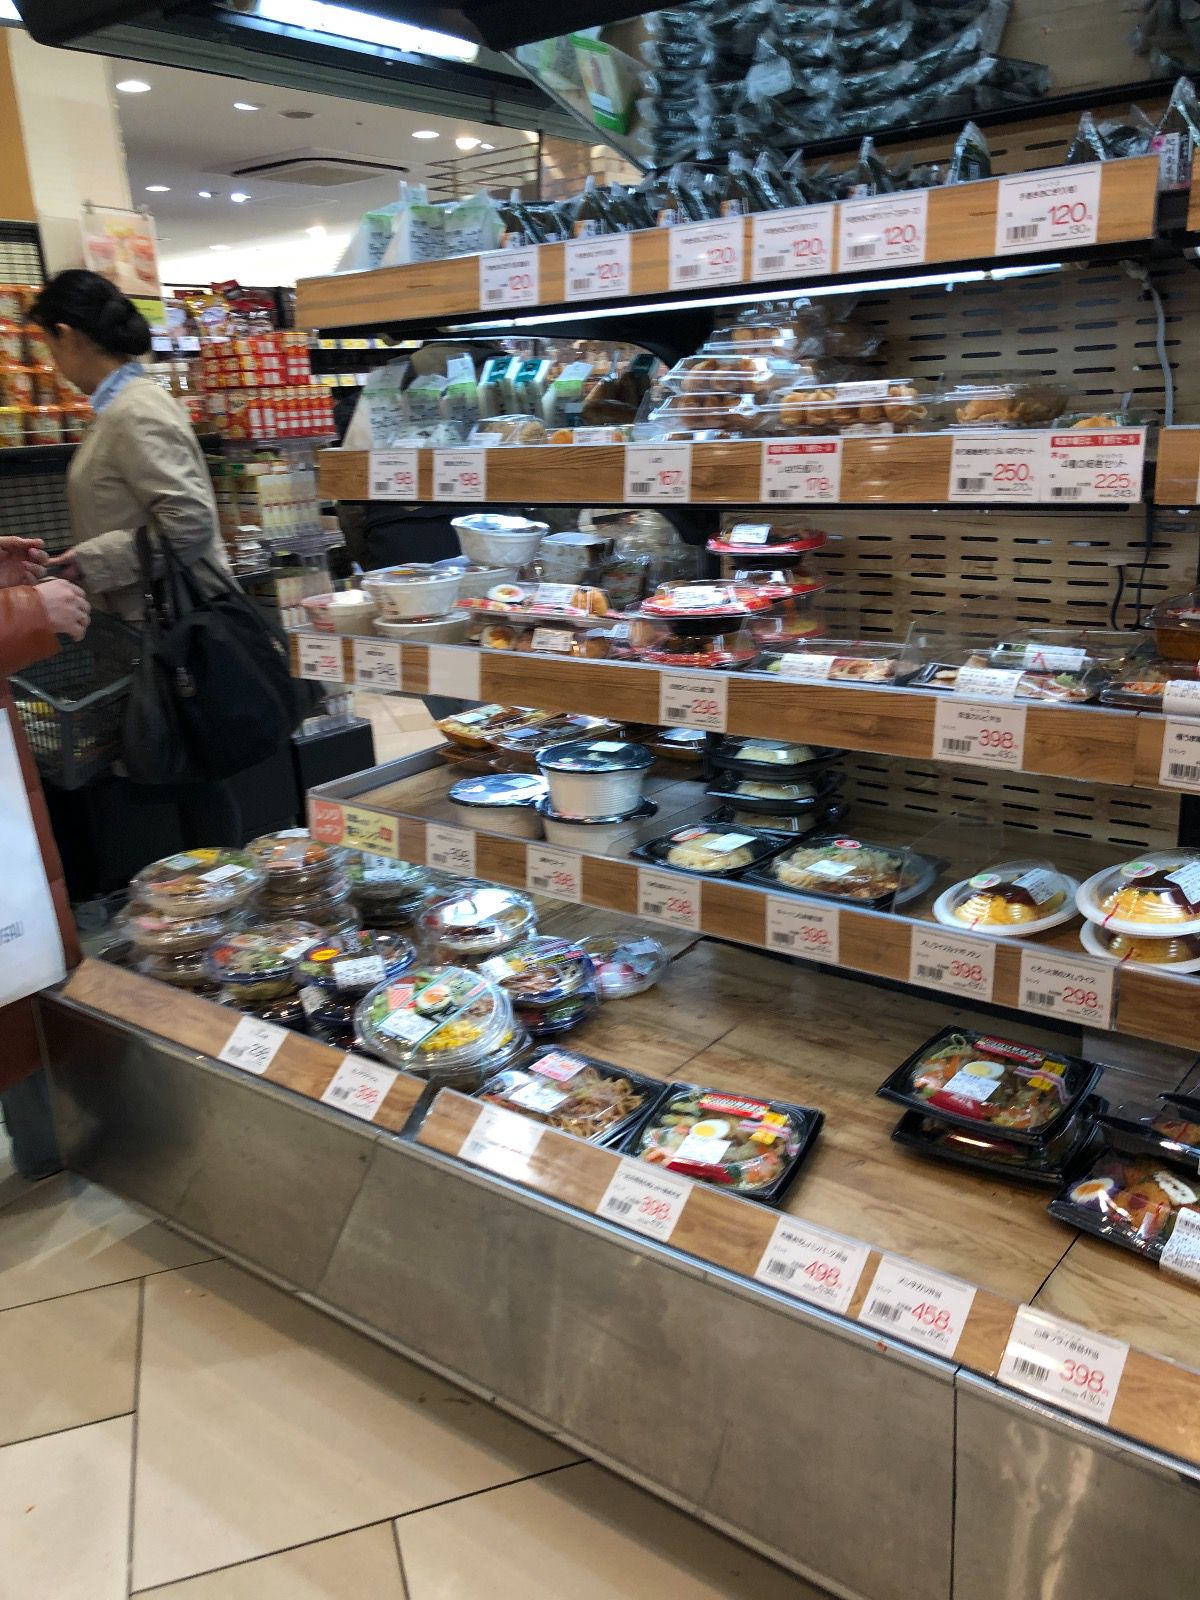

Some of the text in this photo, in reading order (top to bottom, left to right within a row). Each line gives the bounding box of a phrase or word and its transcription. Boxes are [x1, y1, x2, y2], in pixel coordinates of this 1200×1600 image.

[1048, 202, 1087, 226] 120
[884, 224, 917, 246] 120
[993, 463, 1030, 482] 250
[1094, 473, 1131, 489] 225
[978, 728, 1013, 749] 398
[950, 959, 983, 982] 398
[1062, 985, 1098, 1009] 298
[804, 1259, 841, 1287] 498
[911, 1302, 951, 1331] 458
[1059, 1359, 1105, 1393] 398
